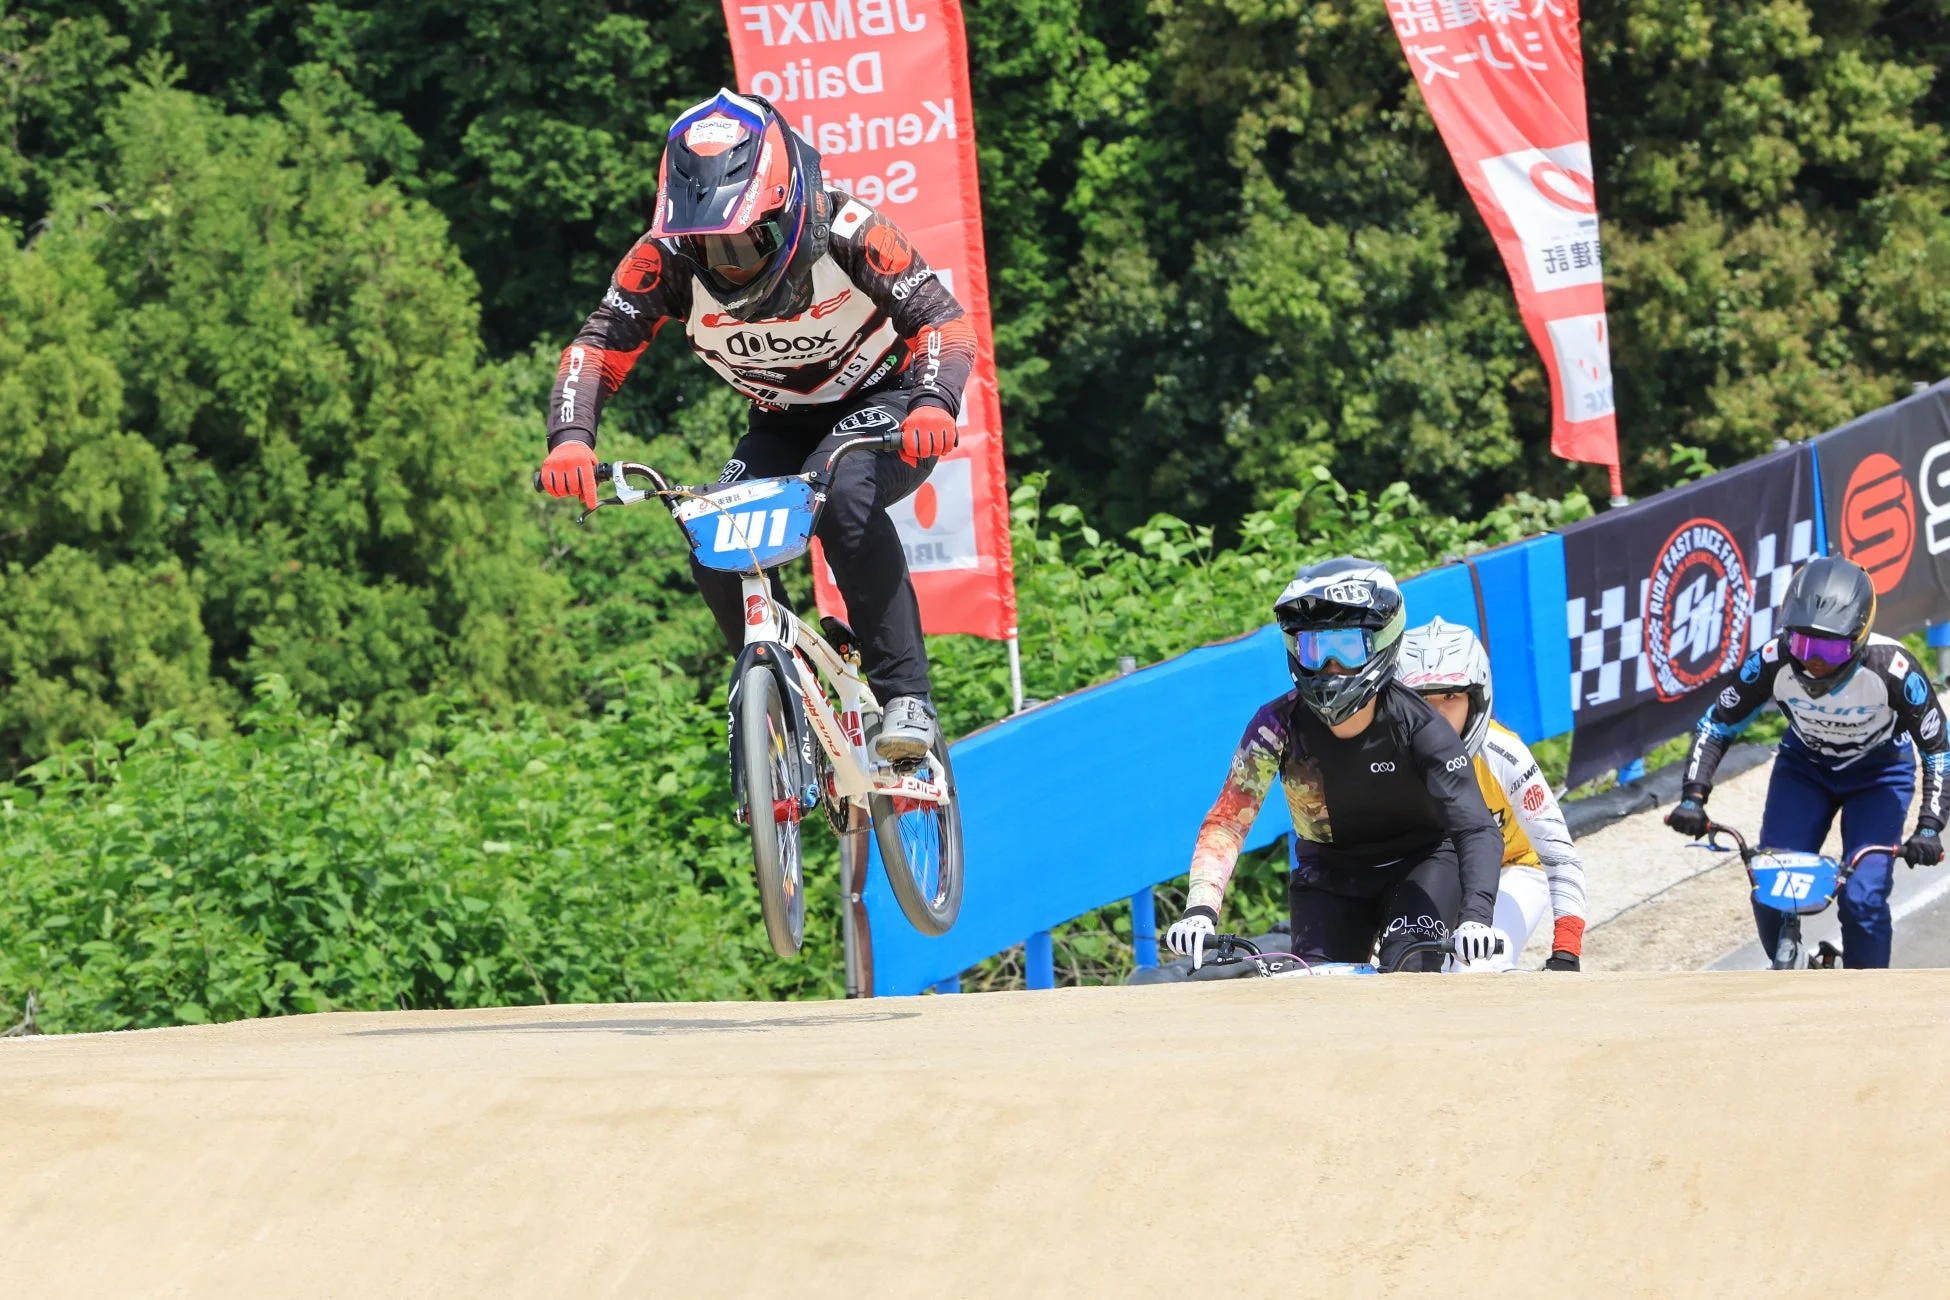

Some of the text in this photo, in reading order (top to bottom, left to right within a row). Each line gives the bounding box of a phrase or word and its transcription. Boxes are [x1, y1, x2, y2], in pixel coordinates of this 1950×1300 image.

[907, 265, 937, 288] box
[611, 291, 641, 320] box
[765, 329, 838, 354] box
[835, 353, 868, 386] FIST
[560, 346, 586, 423] pure
[1650, 527, 1745, 615] RIDE FAST RACE FAST
[1401, 927, 1438, 940] JAPAN
